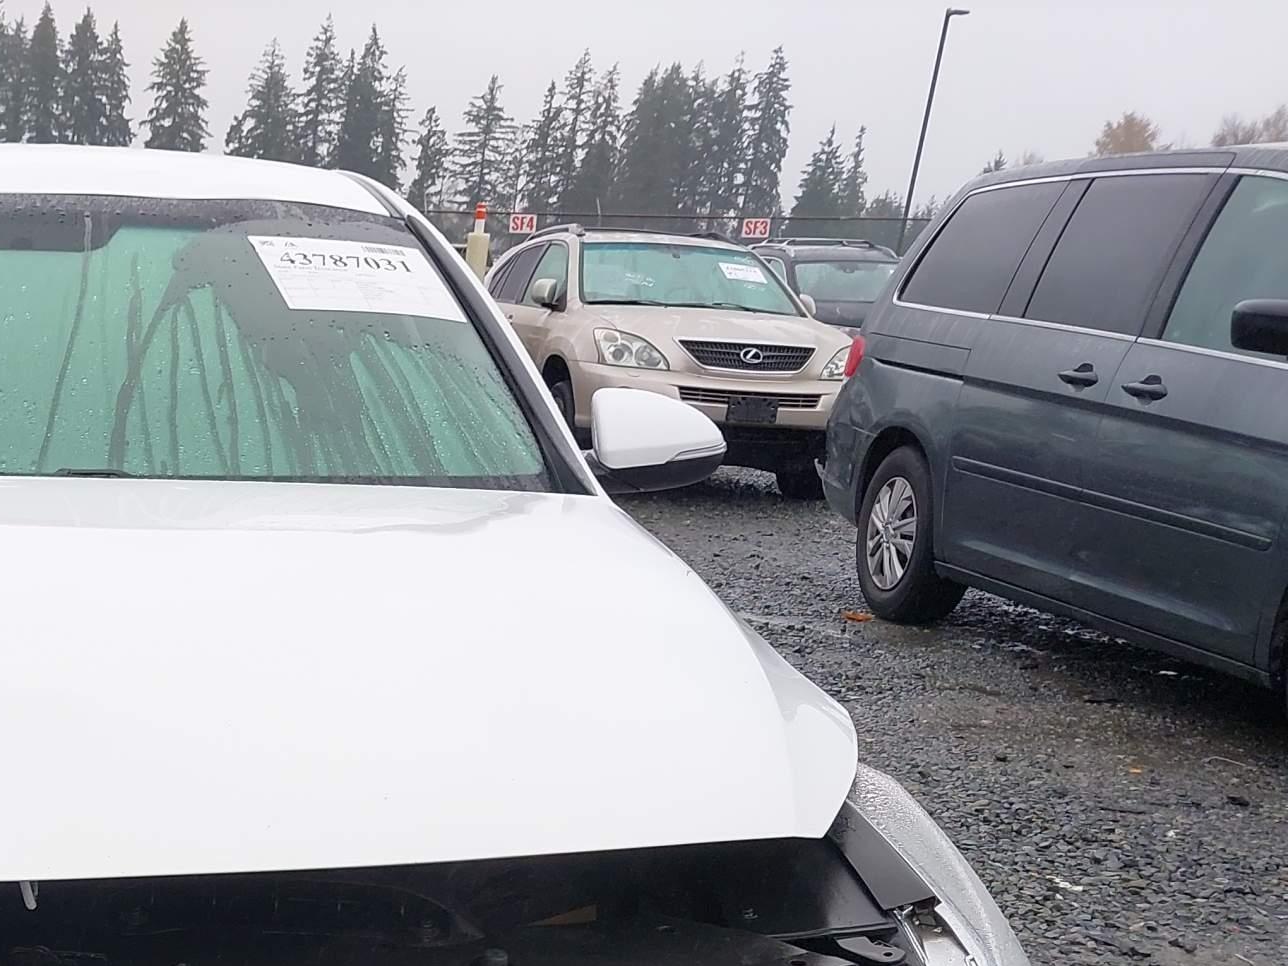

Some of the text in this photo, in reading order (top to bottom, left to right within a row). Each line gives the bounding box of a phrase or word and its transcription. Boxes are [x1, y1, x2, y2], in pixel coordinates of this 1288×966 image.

[511, 215, 535, 231] SF4
[744, 219, 768, 236] SF3
[280, 252, 412, 273] 43787031
